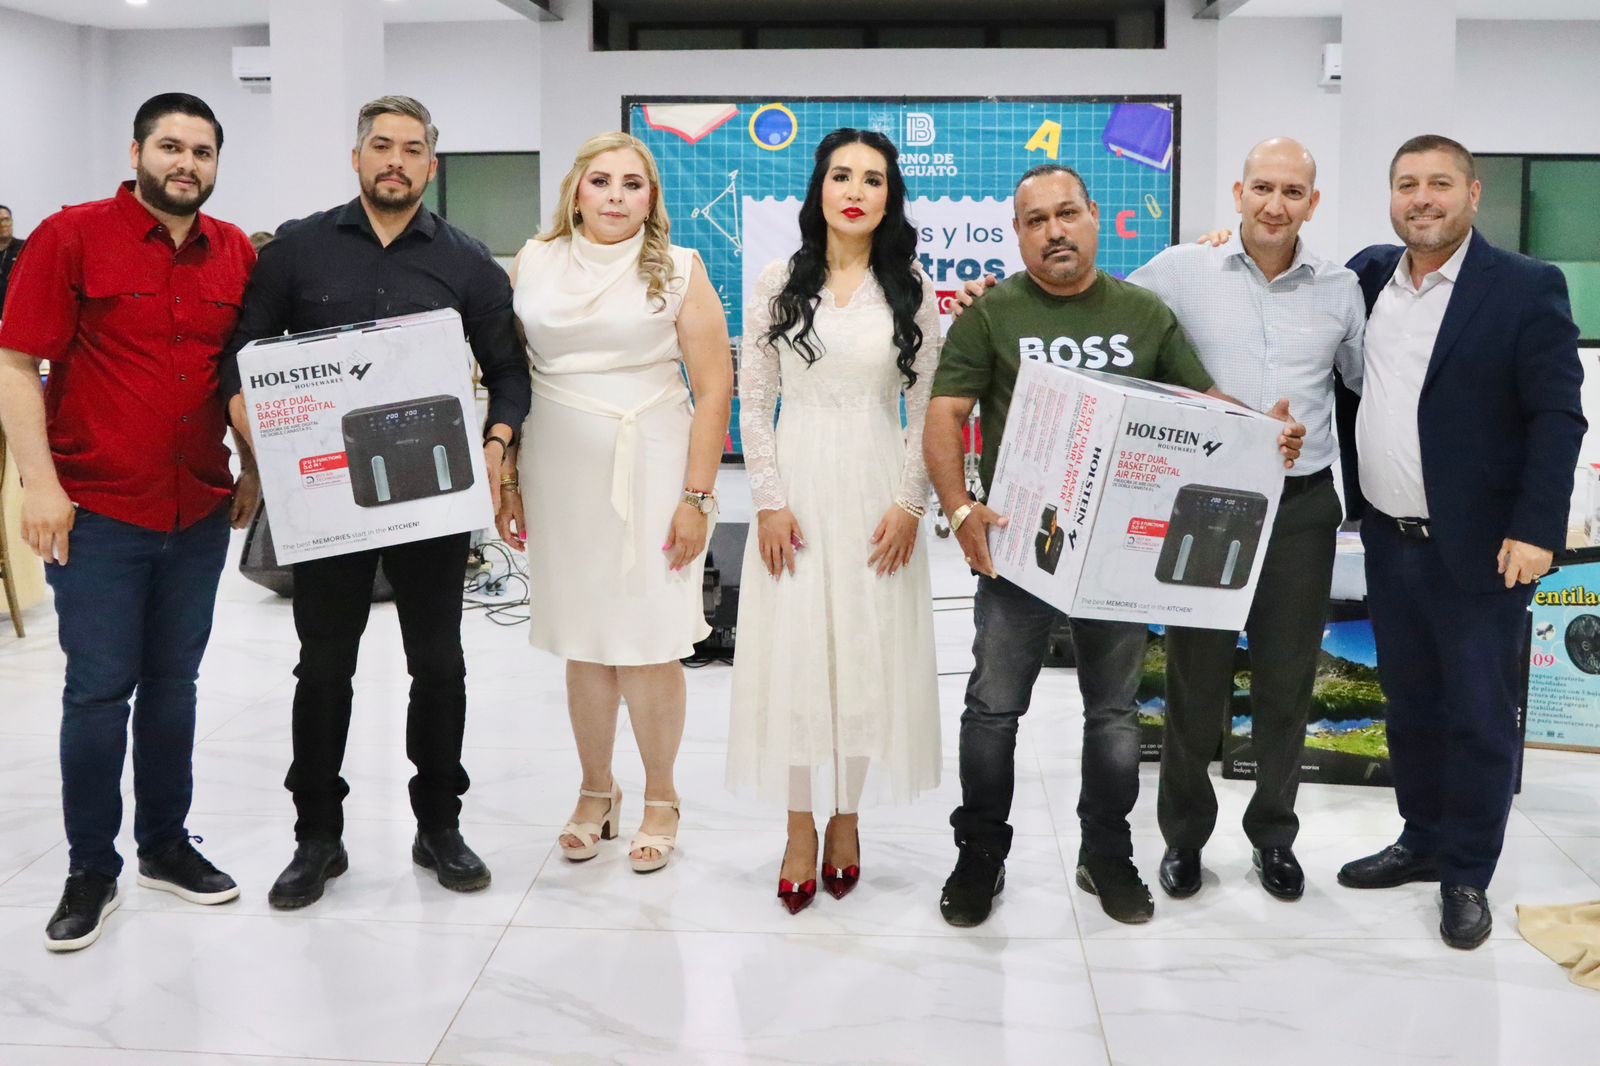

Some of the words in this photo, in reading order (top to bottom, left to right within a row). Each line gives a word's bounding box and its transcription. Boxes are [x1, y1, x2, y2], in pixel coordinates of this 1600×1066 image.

[1024, 119, 1062, 160] A
[897, 153, 930, 164] RNO
[933, 153, 954, 164] DE
[1116, 210, 1138, 239] C
[921, 227, 934, 242] s
[943, 227, 957, 249] y
[966, 222, 1004, 243] los
[918, 253, 1005, 282] tros
[1019, 334, 1134, 369] BOSS
[250, 361, 341, 389] HOLSTEIN
[294, 377, 344, 390] HOUSEWARES
[255, 402, 271, 412] 9.5
[273, 398, 288, 410] QT
[289, 394, 317, 406] DUAL
[257, 407, 295, 421] BASKET
[297, 400, 336, 414] DIGITAL
[1088, 396, 1097, 415] 9.5
[259, 419, 276, 430] AIR
[279, 414, 310, 427] FRYER
[1074, 394, 1091, 438] DIGITAL
[1084, 417, 1093, 435] QT
[1125, 422, 1200, 446] HOLSTEIN
[1070, 441, 1080, 461] AIR
[1073, 436, 1088, 466] DUAL
[1120, 450, 1133, 460] 9.5
[1134, 452, 1146, 461] QT
[1147, 454, 1168, 465] DUAL
[1157, 443, 1197, 454] HOUSEWARES
[1115, 470, 1129, 479] AIR
[1130, 471, 1157, 482] FRYER
[1117, 460, 1150, 472] BASKET
[1150, 465, 1181, 477] DIGITAL
[1060, 463, 1075, 500] FRYER
[1076, 446, 1102, 525] HOLSTEIN
[1063, 469, 1081, 515] BASKET
[312, 533, 351, 545] MEMORIES
[1105, 599, 1138, 609] MEMORIES
[1535, 586, 1600, 606] entila
[1533, 653, 1555, 667] 09
